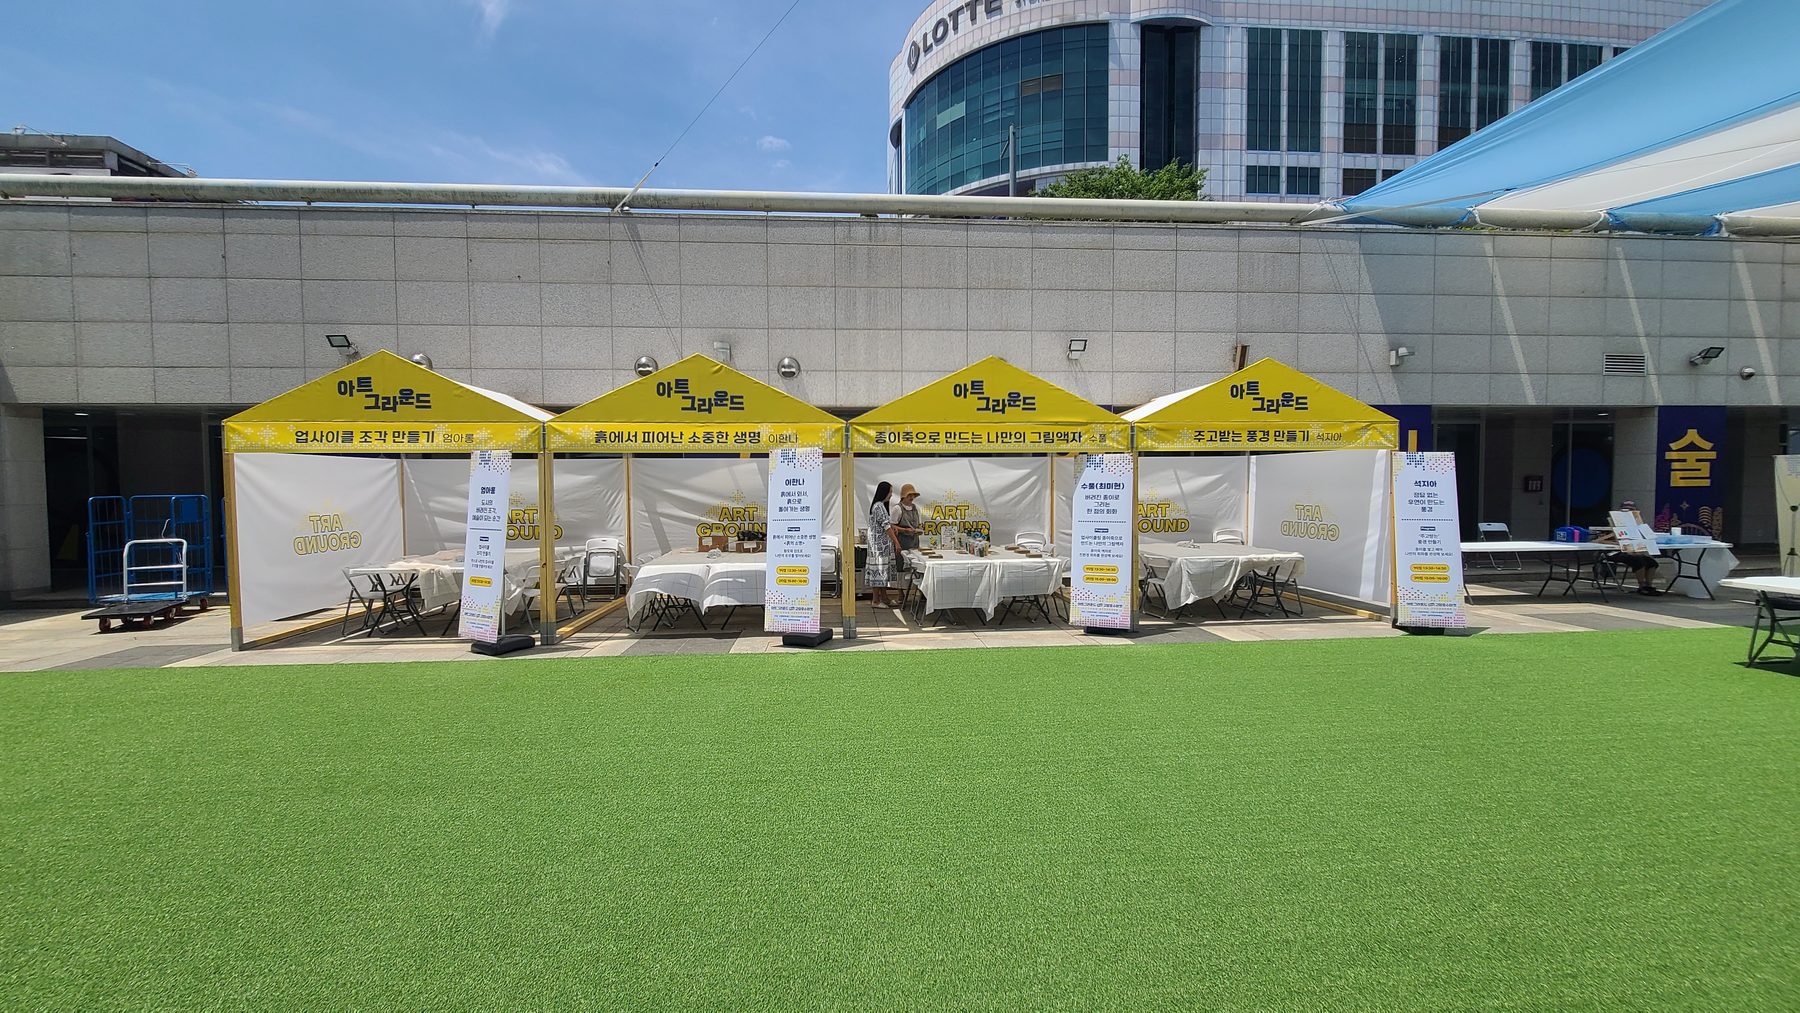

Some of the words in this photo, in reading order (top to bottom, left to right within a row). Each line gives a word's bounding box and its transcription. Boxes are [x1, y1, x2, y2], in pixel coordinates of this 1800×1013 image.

[922, 0, 1003, 51] LOTTE
[337, 376, 373, 397] 아트
[656, 378, 690, 398] 아트
[953, 380, 985, 399] 아트
[1230, 381, 1260, 400] 아트
[364, 388, 432, 413] 그라운드
[680, 390, 745, 414] 그라운드
[976, 391, 1037, 415] 그라운드
[1252, 392, 1309, 414] 그라운드
[294, 430, 355, 444] 업사이클
[359, 430, 388, 444] 조각
[392, 430, 435, 444] 만들기
[594, 430, 638, 444] 흙에서
[641, 430, 684, 444] 피어난
[688, 430, 729, 444] 소중한
[733, 430, 761, 444] 생명
[768, 433, 799, 445] 이한나
[874, 431, 941, 445] 종이죽으로
[944, 431, 983, 444] 만드는
[987, 431, 1026, 444] 나만의
[1030, 431, 1083, 445] 그림액자
[1193, 430, 1242, 443] 주고받는
[1246, 430, 1270, 443] 풍경
[1273, 430, 1310, 443] 만들기
[1316, 432, 1342, 442] 석지아
[1665, 428, 1717, 487] 술
[784, 478, 805, 486] 이한나
[1413, 480, 1437, 488] 석지아
[719, 506, 758, 521] ART
[931, 505, 969, 520] ART
[696, 522, 767, 537] GROUN
[1138, 518, 1190, 533] OUND
